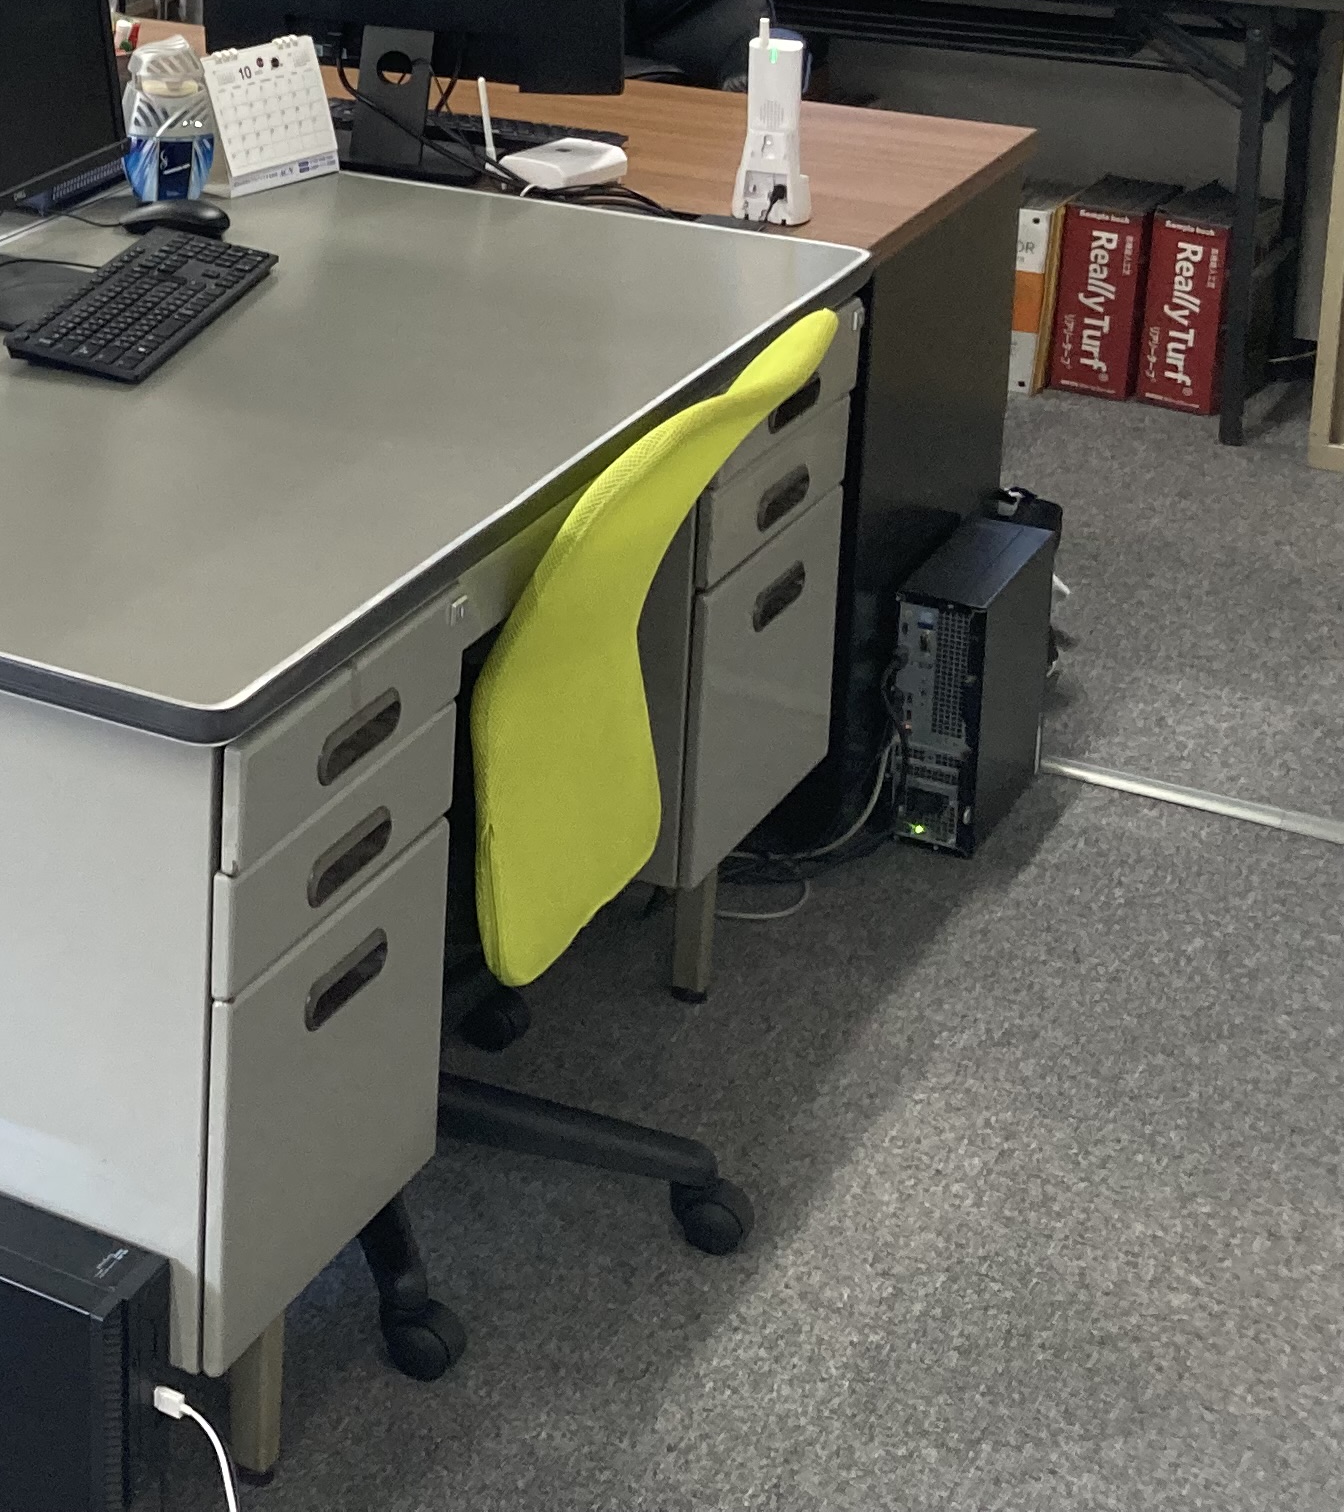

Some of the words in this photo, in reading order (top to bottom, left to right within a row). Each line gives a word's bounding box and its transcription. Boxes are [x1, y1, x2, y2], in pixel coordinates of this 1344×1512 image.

[238, 66, 252, 80] 10
[1078, 230, 1118, 313] Really
[1164, 241, 1204, 326] Really
